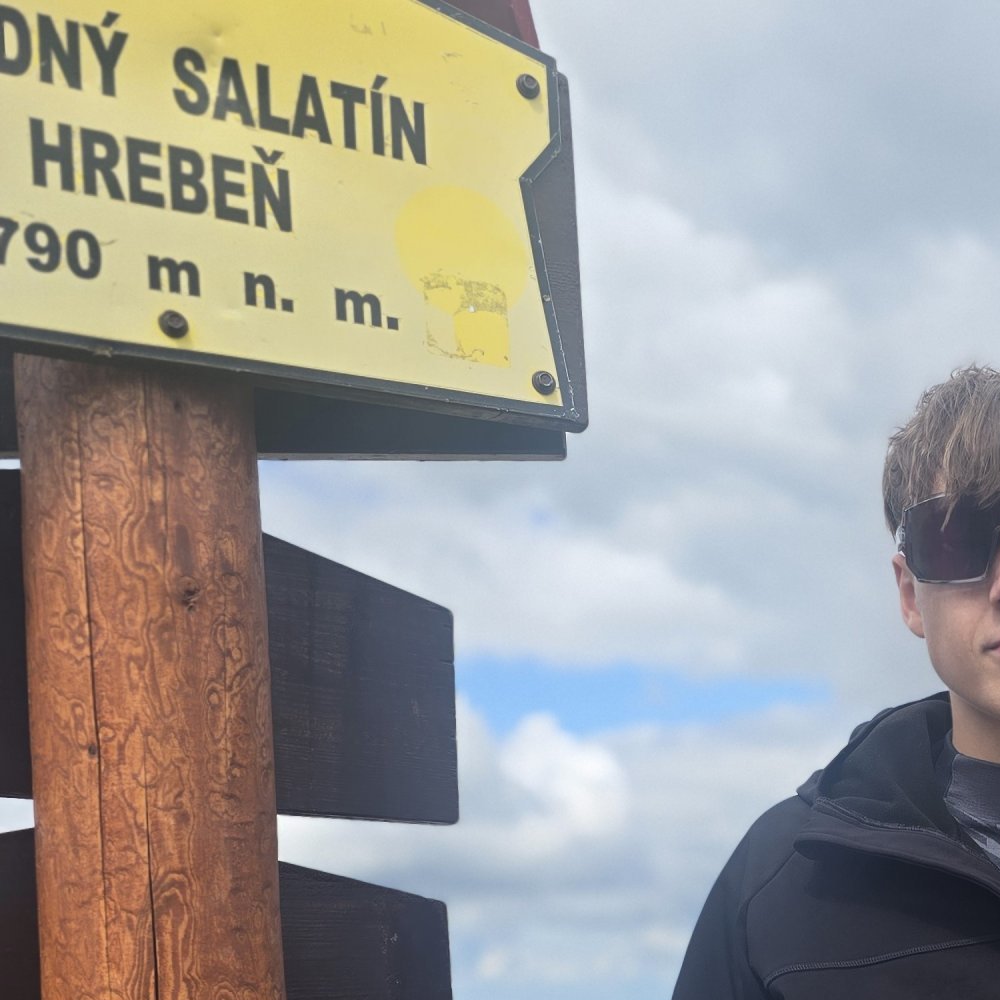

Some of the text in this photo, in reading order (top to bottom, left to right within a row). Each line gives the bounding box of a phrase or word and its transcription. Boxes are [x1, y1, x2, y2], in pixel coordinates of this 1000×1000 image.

[0, 5, 428, 166] DNÝ SALATÍN
[29, 117, 293, 233] HREBEŇ
[147, 254, 201, 297] m
[244, 271, 294, 313] n.
[334, 287, 399, 331] m.
